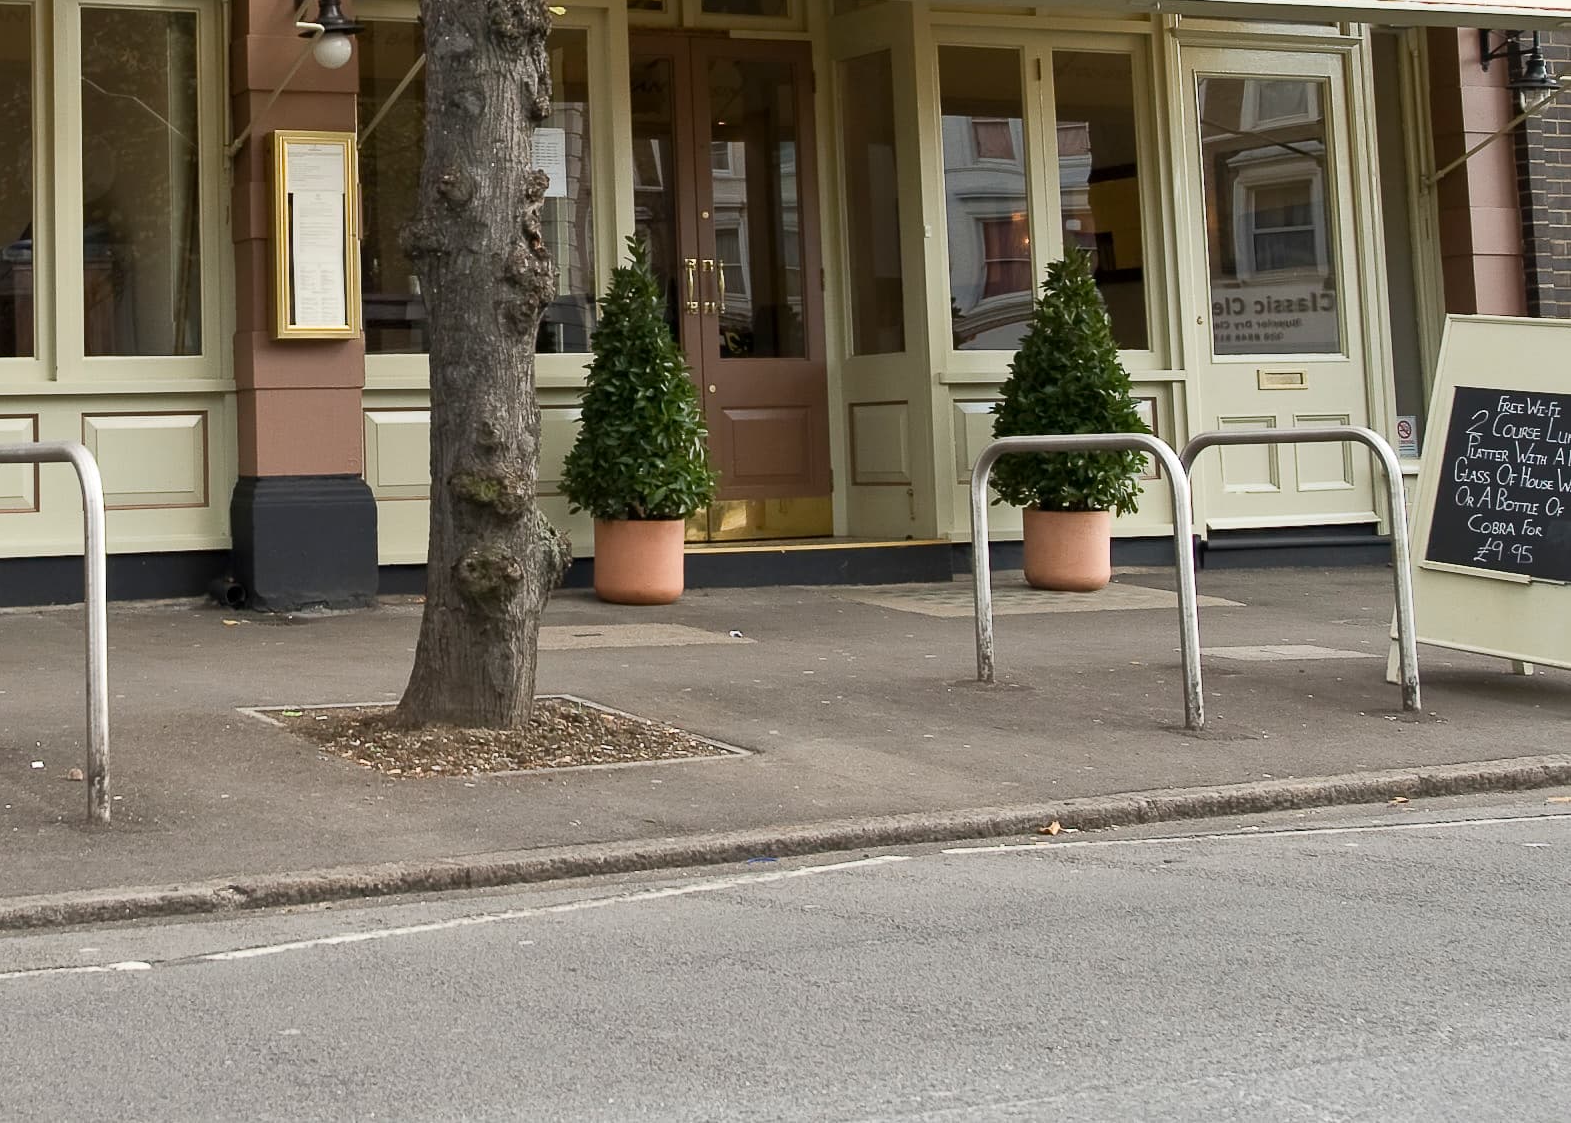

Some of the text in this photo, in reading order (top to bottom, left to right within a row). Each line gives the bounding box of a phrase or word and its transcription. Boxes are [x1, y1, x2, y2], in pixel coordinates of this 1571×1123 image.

[1465, 409, 1489, 436] 2
[1552, 447, 1565, 466] A
[1476, 486, 1491, 510] A
